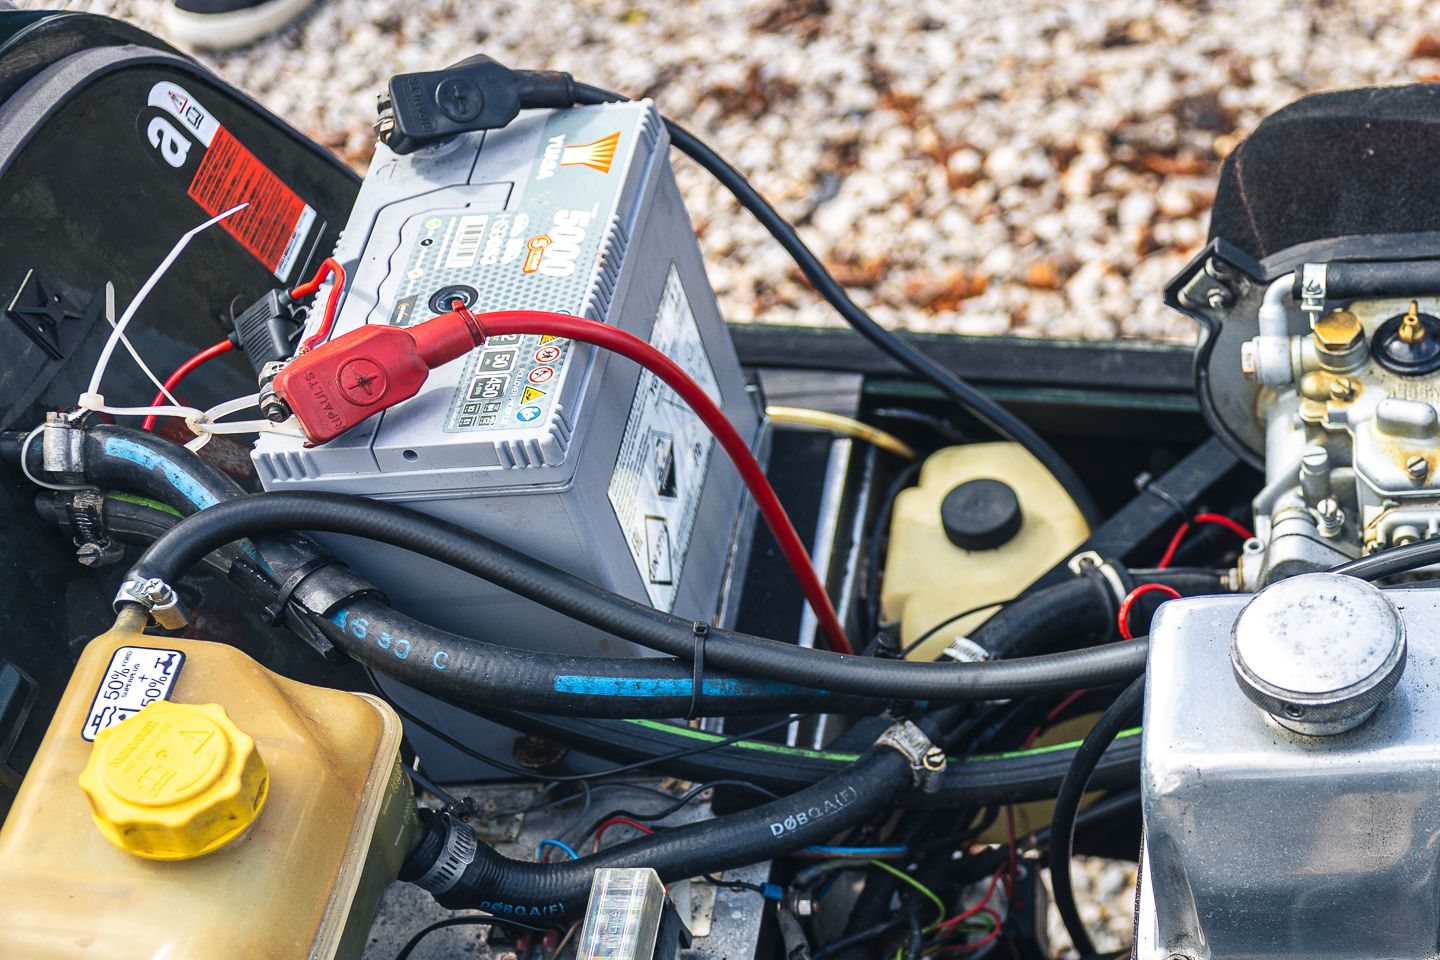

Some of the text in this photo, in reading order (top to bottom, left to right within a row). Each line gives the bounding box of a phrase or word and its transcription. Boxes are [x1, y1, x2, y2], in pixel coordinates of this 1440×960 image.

[535, 133, 567, 181] YUASA
[539, 209, 590, 277] 5000
[494, 352, 510, 369] 50
[304, 371, 345, 431] RIPAULTS
[482, 377, 504, 398] 450
[104, 650, 133, 700] 50% FORD
[121, 663, 141, 698] SUPERPLUS
